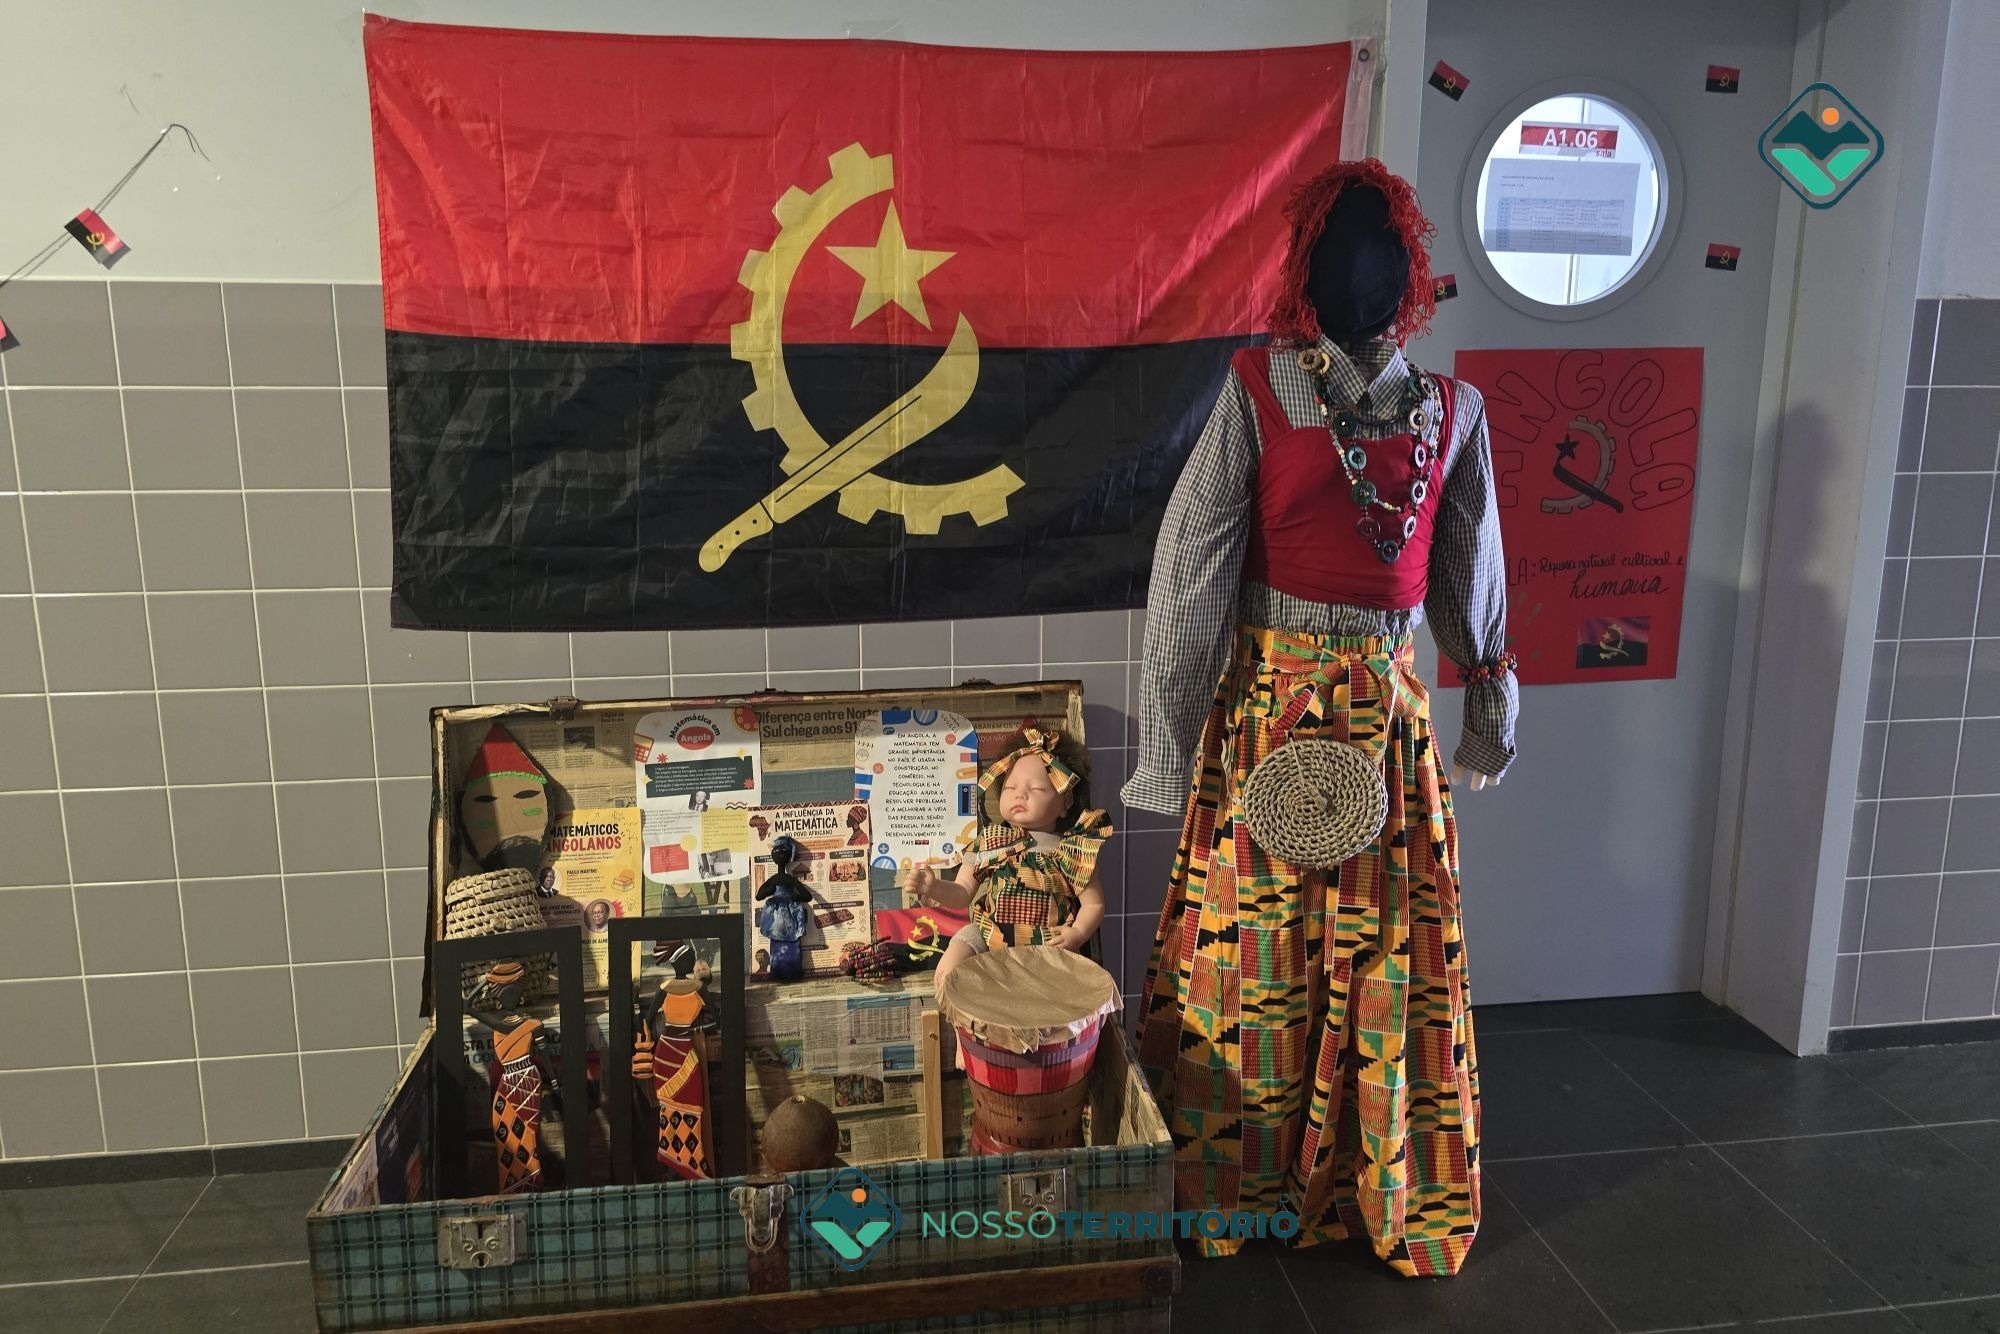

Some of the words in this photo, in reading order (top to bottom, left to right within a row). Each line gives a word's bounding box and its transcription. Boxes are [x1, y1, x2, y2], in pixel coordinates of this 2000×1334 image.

[1543, 128, 1598, 148] A1.06
[813, 709, 845, 721] entre
[669, 713, 712, 739] Matemática
[711, 724, 721, 736] em
[763, 724, 782, 738] Sul
[784, 723, 820, 738] chega
[822, 725, 844, 735] aos
[681, 733, 711, 744] Angola
[782, 808, 823, 818] INFLUÊNCIA
[825, 808, 835, 816] DA
[550, 821, 619, 838] MATEMÁTICOS
[774, 815, 838, 832] MATEMÁTICA
